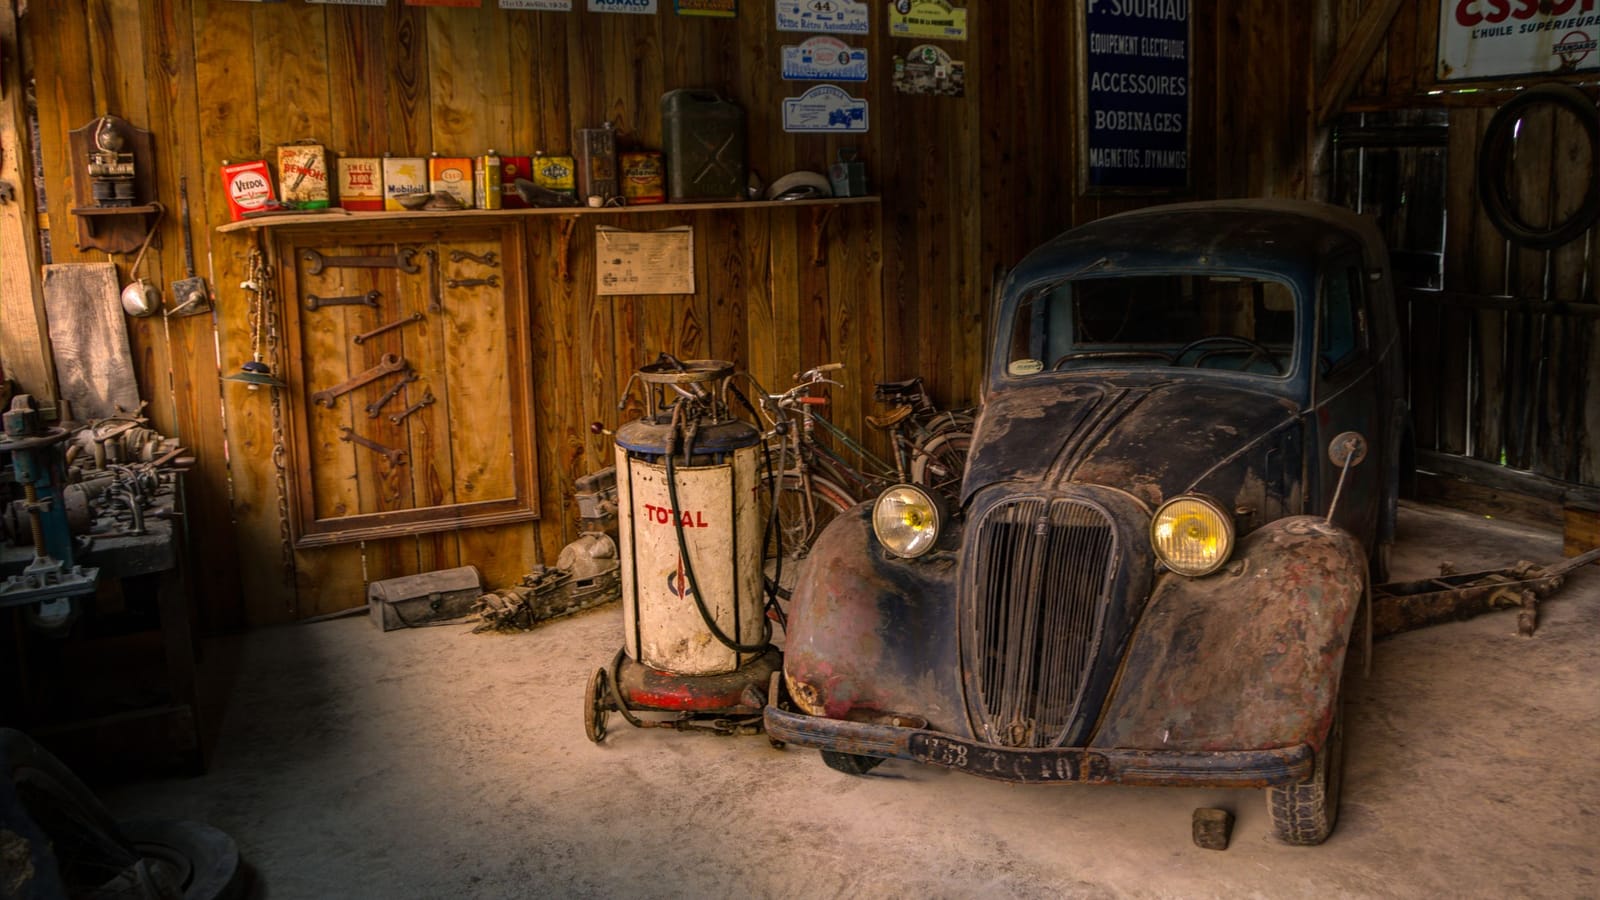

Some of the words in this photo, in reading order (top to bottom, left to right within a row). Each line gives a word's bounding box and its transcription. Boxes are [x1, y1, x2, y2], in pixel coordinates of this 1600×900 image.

[814, 2, 830, 11] 44
[1472, 26, 1513, 39] L'HUILE
[1091, 72, 1186, 96] ACCESSOIRES
[1095, 109, 1183, 133] BOBINAGES
[234, 179, 265, 193] VEEDOL
[388, 184, 425, 193] Mobiloil
